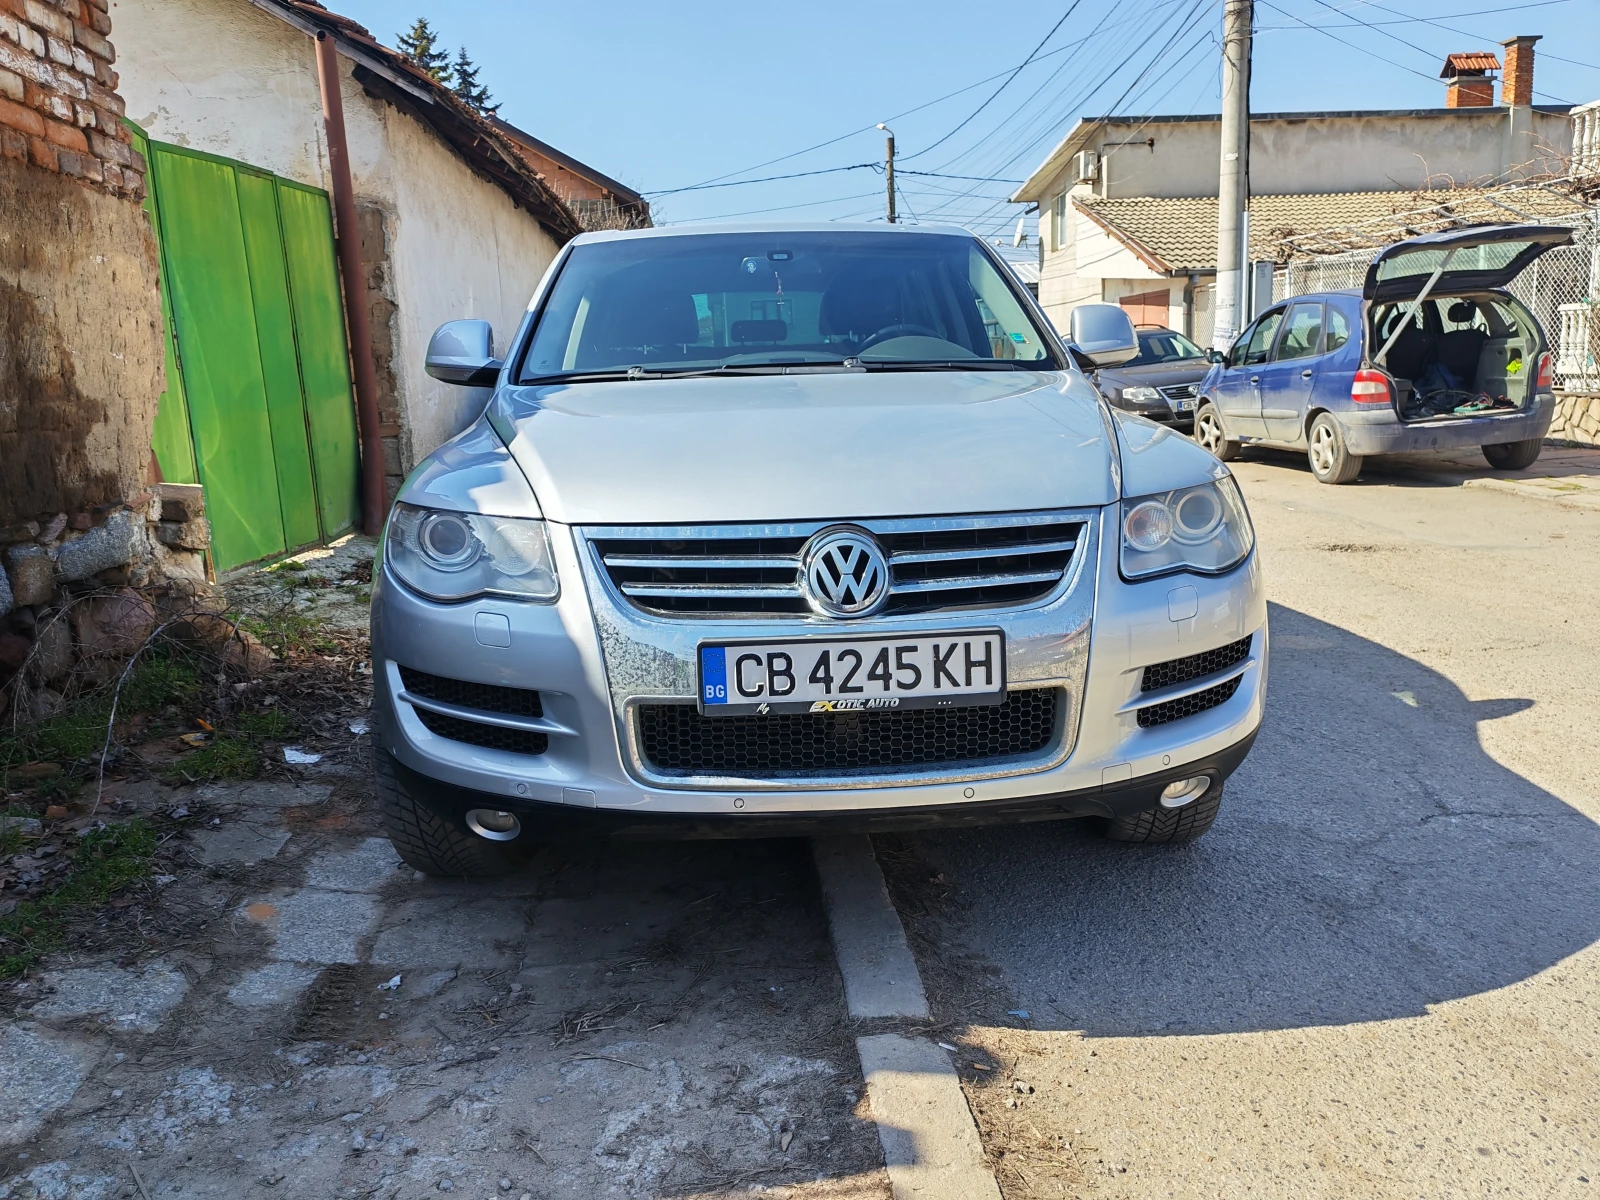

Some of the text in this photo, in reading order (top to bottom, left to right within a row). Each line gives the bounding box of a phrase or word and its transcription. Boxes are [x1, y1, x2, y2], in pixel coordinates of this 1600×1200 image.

[811, 541, 883, 611] VW
[735, 641, 993, 698] CB 4245 KH
[705, 684, 725, 699] BG
[809, 699, 866, 713] EXOTIC
[865, 697, 900, 709] AUTO
